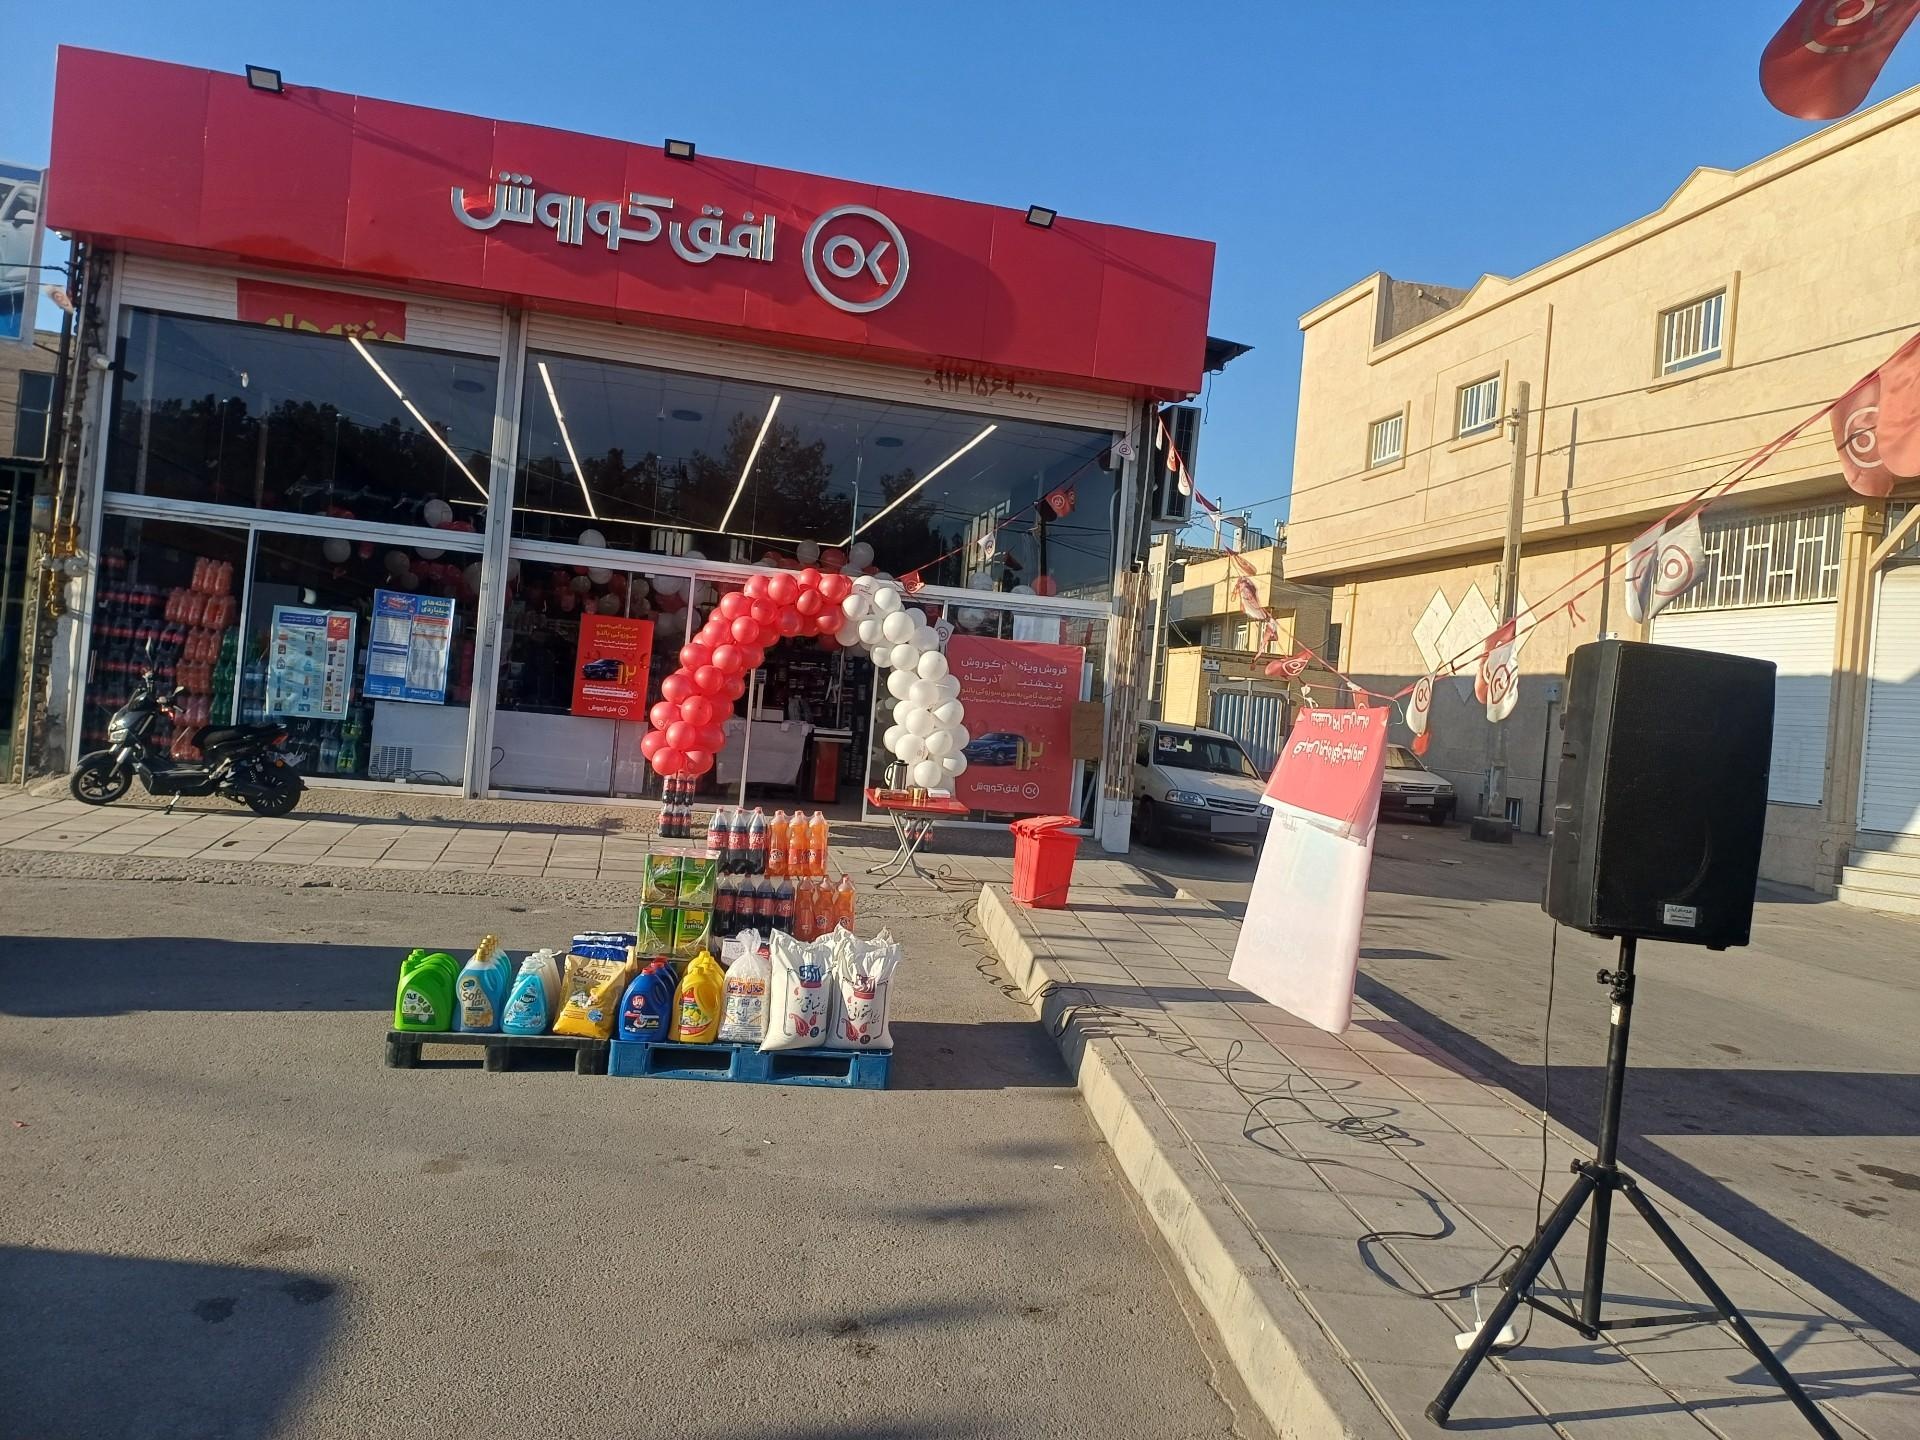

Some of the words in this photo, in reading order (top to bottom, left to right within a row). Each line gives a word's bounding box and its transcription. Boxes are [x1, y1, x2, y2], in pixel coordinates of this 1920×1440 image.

[450, 171, 674, 251] کوروش
[668, 205, 776, 263] افق
[961, 656, 1001, 669] کوروش
[1018, 661, 1038, 674] ویژه
[1039, 663, 1067, 676] فروش
[963, 672, 987, 682] ماه
[1016, 678, 1063, 694] پنجشنب
[970, 781, 1004, 793] کوروش
[1002, 783, 1020, 794] افق
